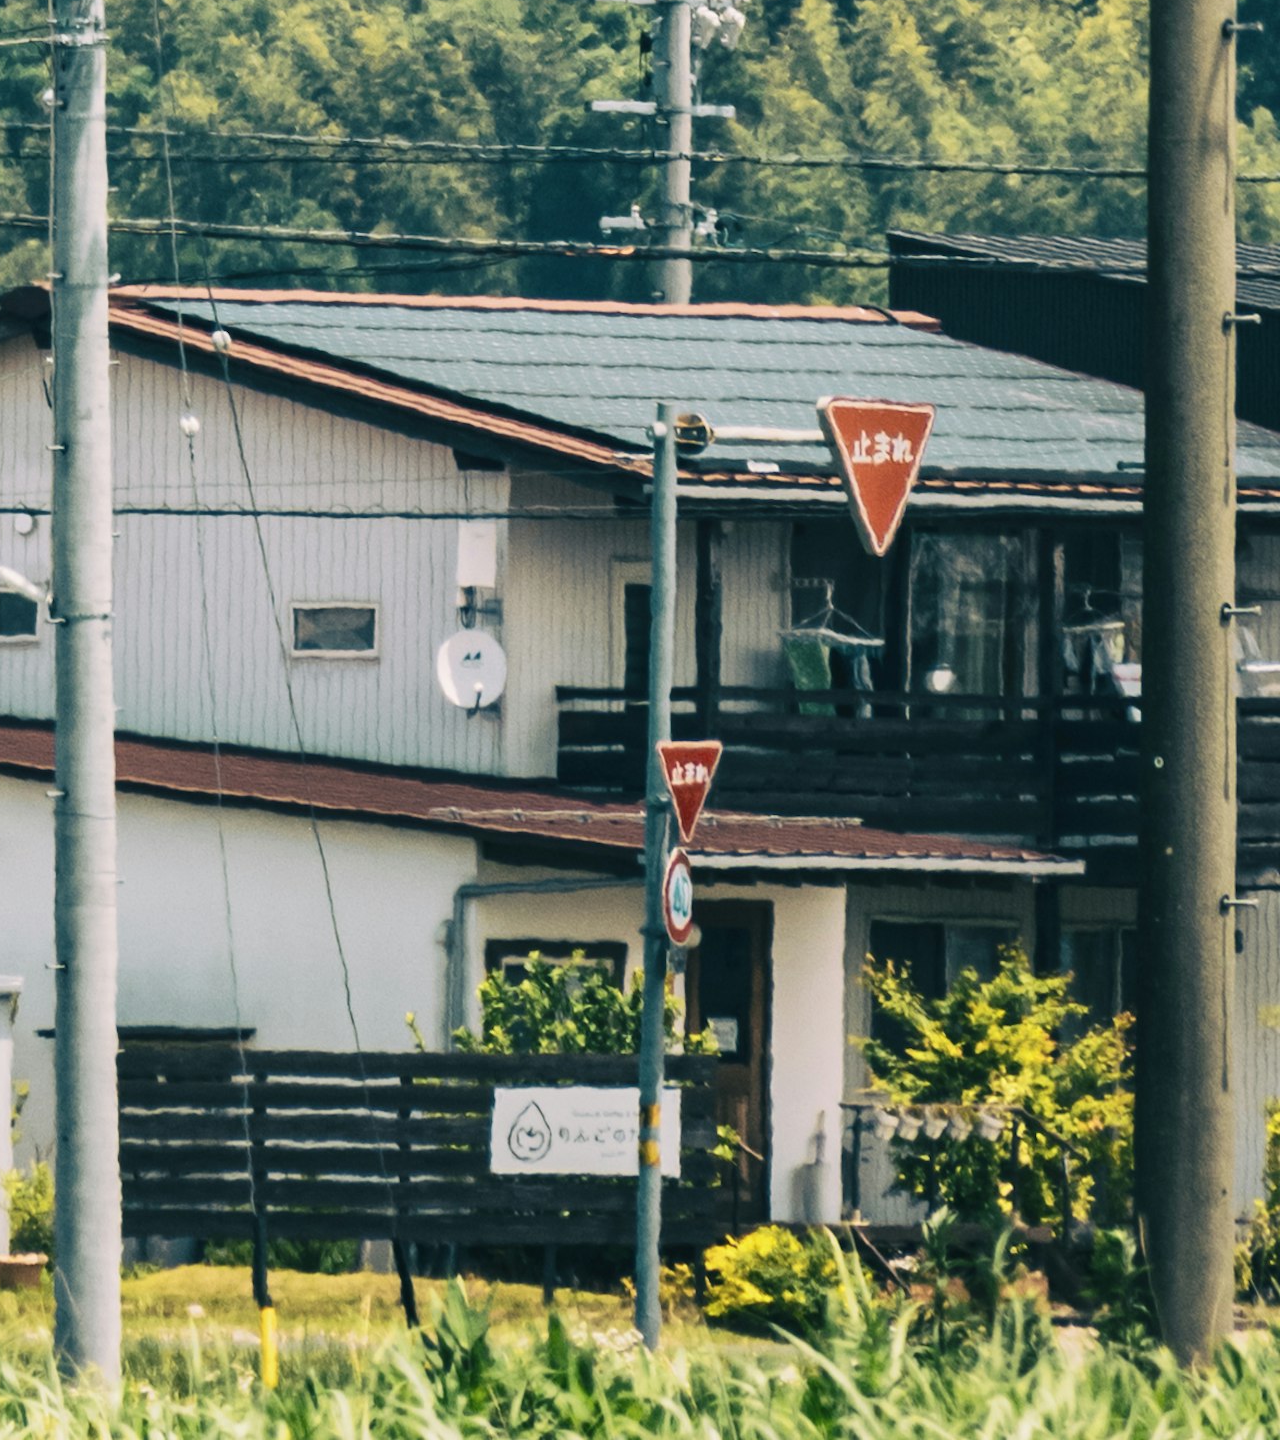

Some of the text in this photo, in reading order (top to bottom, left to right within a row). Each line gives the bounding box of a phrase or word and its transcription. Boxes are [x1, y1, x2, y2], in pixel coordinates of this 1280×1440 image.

[852, 429, 914, 465] 止まれ
[671, 761, 710, 785] 止まれ
